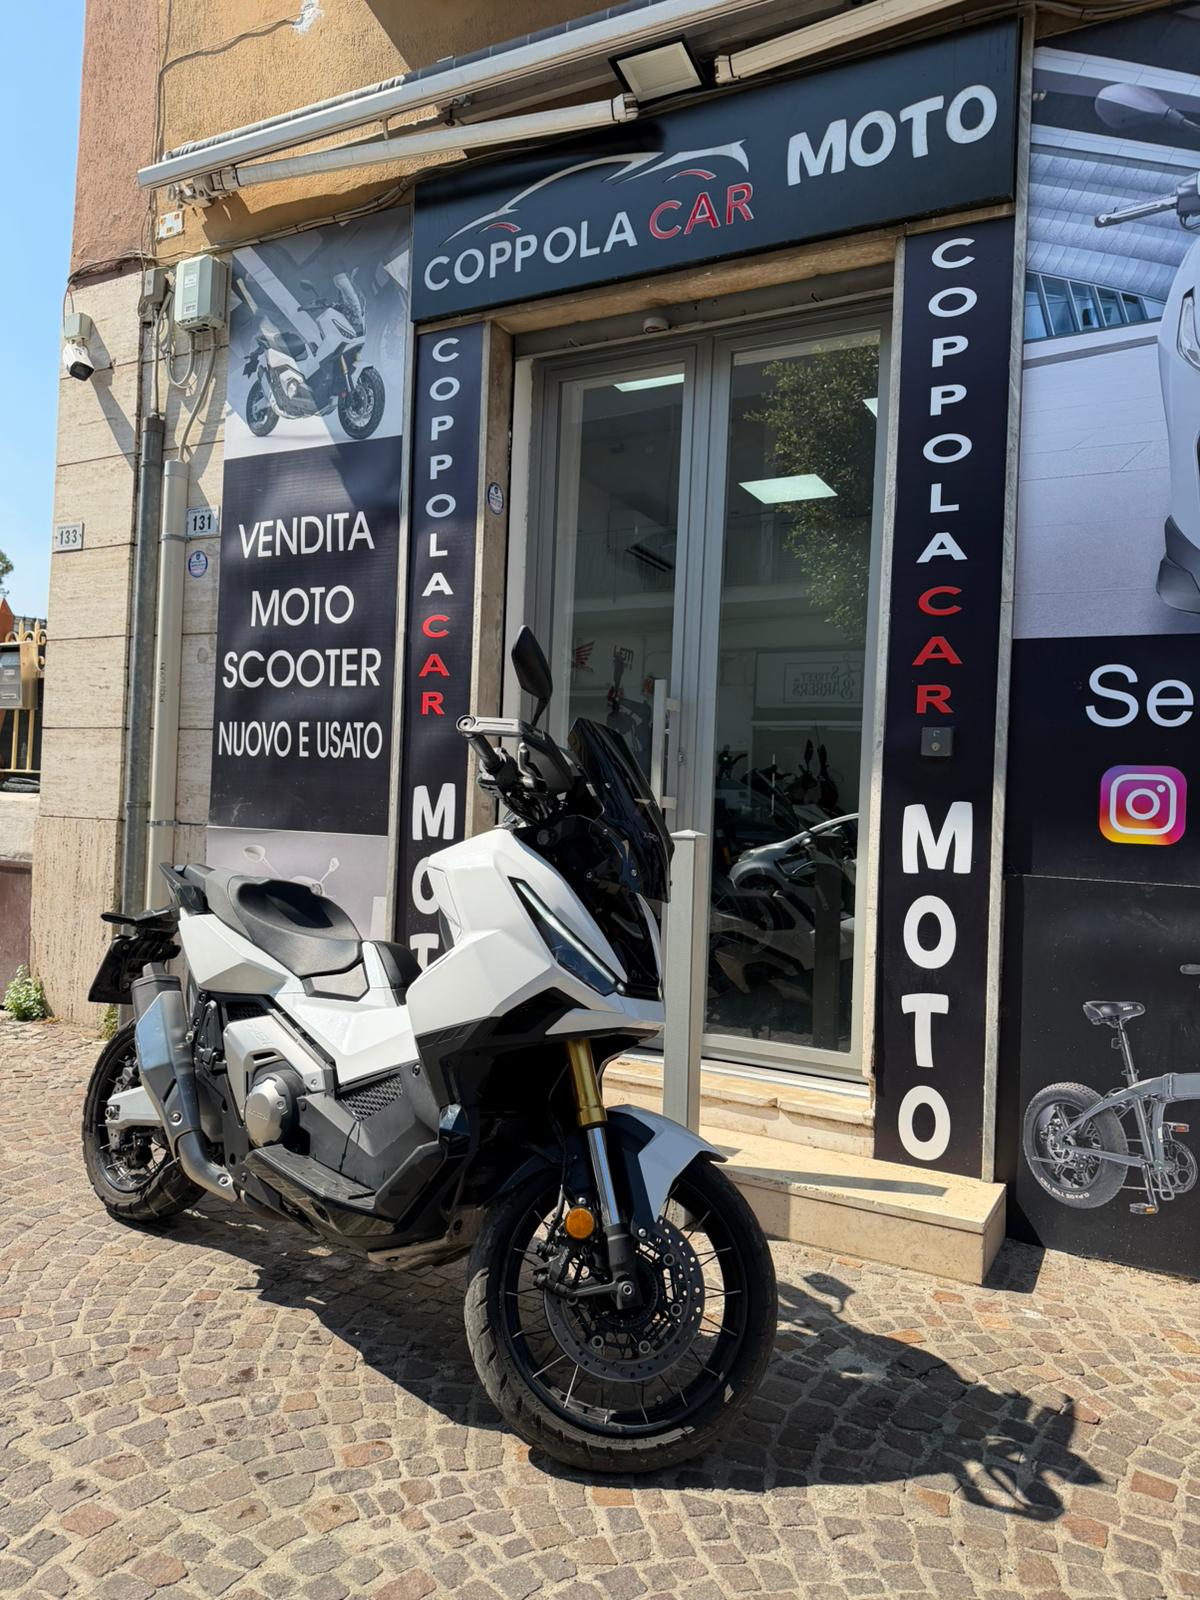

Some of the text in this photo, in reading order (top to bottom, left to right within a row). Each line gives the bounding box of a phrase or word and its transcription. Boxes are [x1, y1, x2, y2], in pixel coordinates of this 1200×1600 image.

[424, 84, 998, 291] COPPOLA CAR MOTO
[60, 529, 78, 545] 133
[193, 514, 212, 531] 131
[239, 511, 375, 559] VENDITA
[250, 585, 355, 628] MOTO
[222, 647, 382, 689] SCOOTER
[410, 338, 460, 972] COPPOLA CAR MOT
[897, 237, 978, 1162] COPPOLA CAR MOTO
[1085, 664, 1195, 727] Se
[218, 720, 383, 759] NUOVO E USATO
